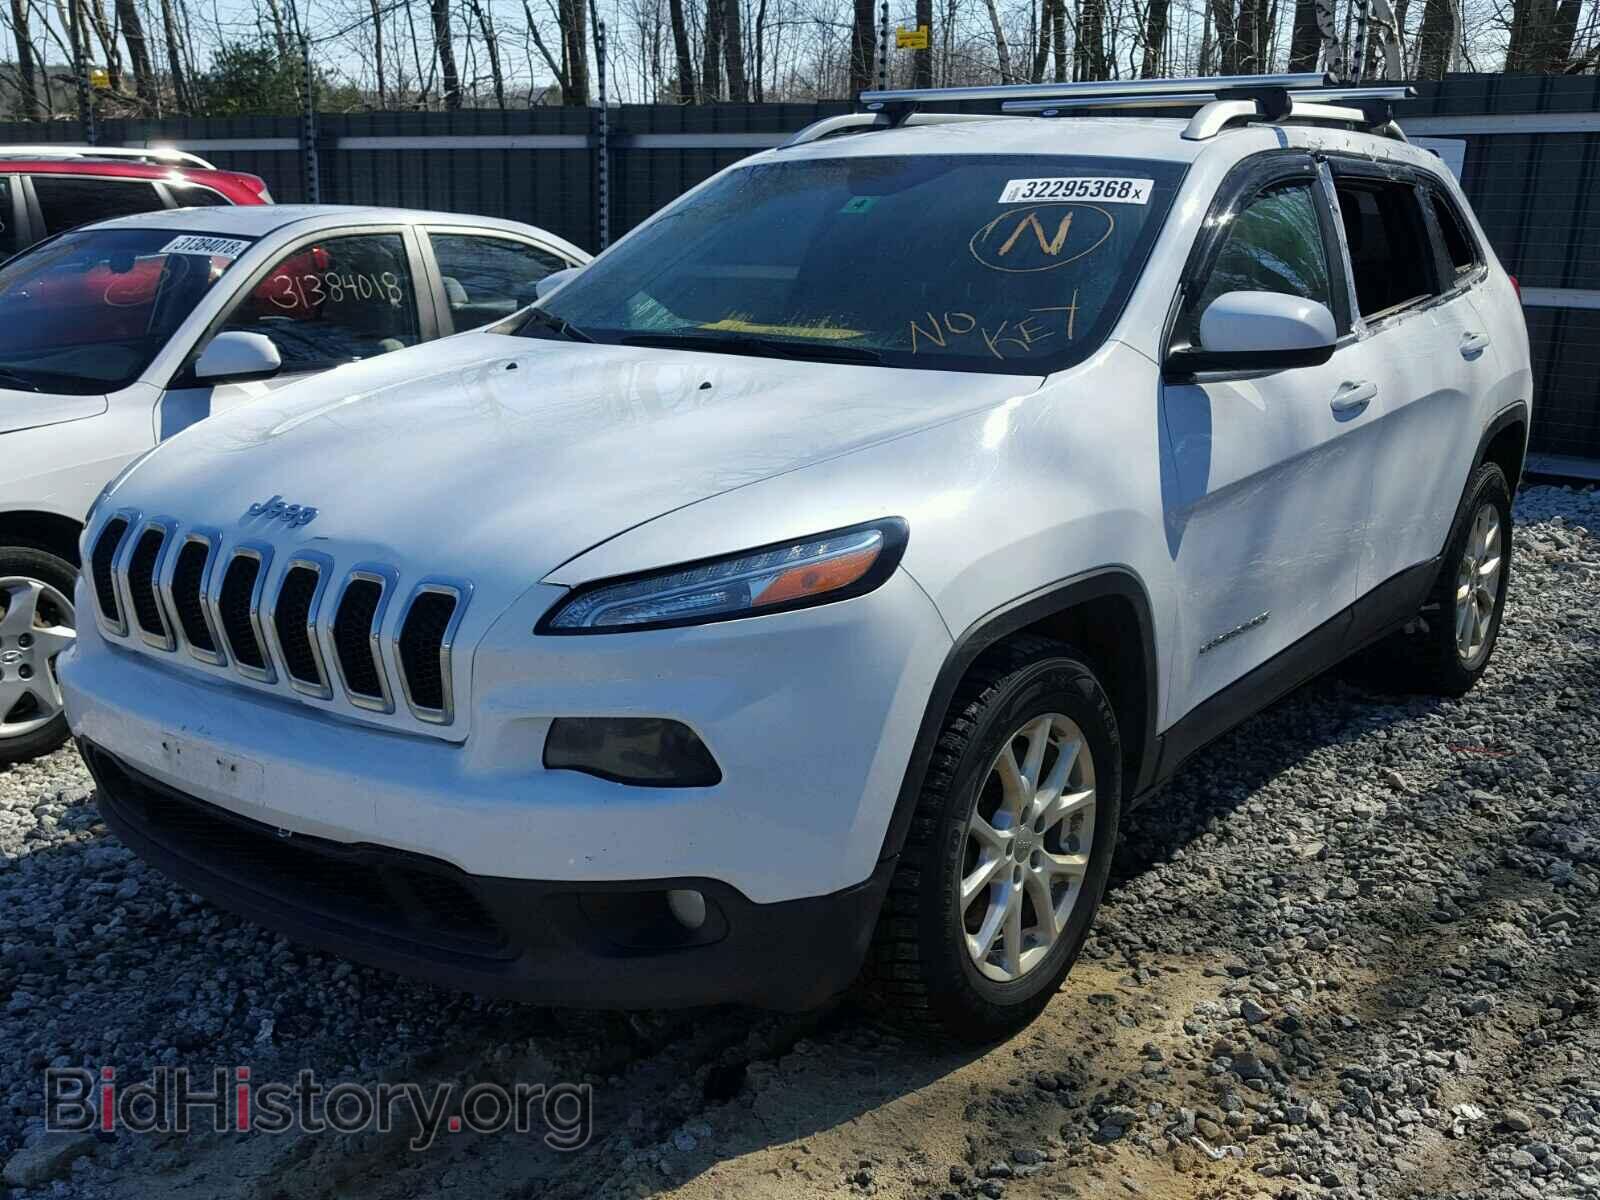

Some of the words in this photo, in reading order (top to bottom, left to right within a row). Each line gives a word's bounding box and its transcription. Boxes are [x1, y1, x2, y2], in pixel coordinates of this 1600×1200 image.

[998, 211, 1074, 256] N
[270, 271, 402, 309] 31384018
[910, 311, 976, 354] NO
[248, 495, 320, 528] Jeep
